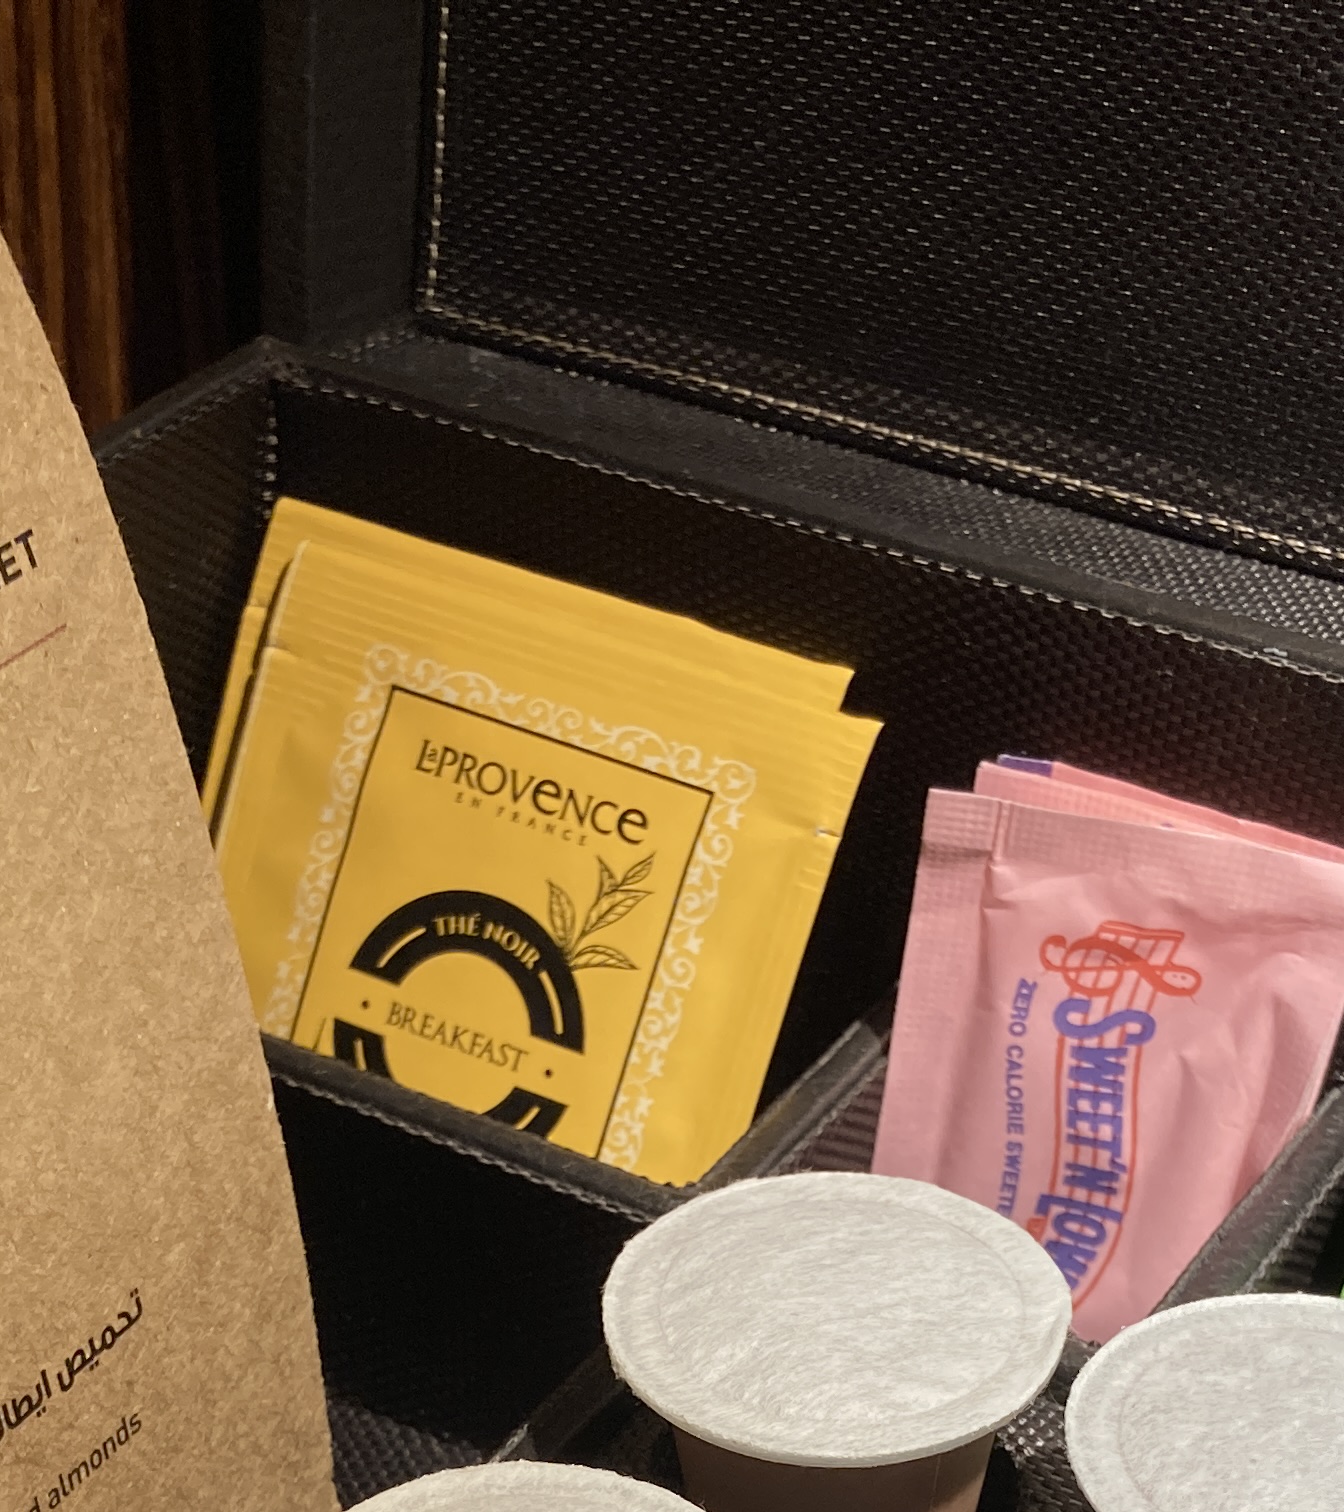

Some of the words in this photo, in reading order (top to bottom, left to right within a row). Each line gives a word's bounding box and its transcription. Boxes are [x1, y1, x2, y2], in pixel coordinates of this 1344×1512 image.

[455, 791, 481, 810] EN
[495, 805, 588, 848] FRANCE
[434, 913, 480, 937] THÉ
[484, 919, 541, 970] NOIR
[386, 1002, 528, 1073] BREAKFAST
[1009, 977, 1038, 1037] ZERO
[1005, 1045, 1024, 1136] CALORIE
[57, 1288, 142, 1391] تحميص
[48, 1412, 142, 1509] almonds
